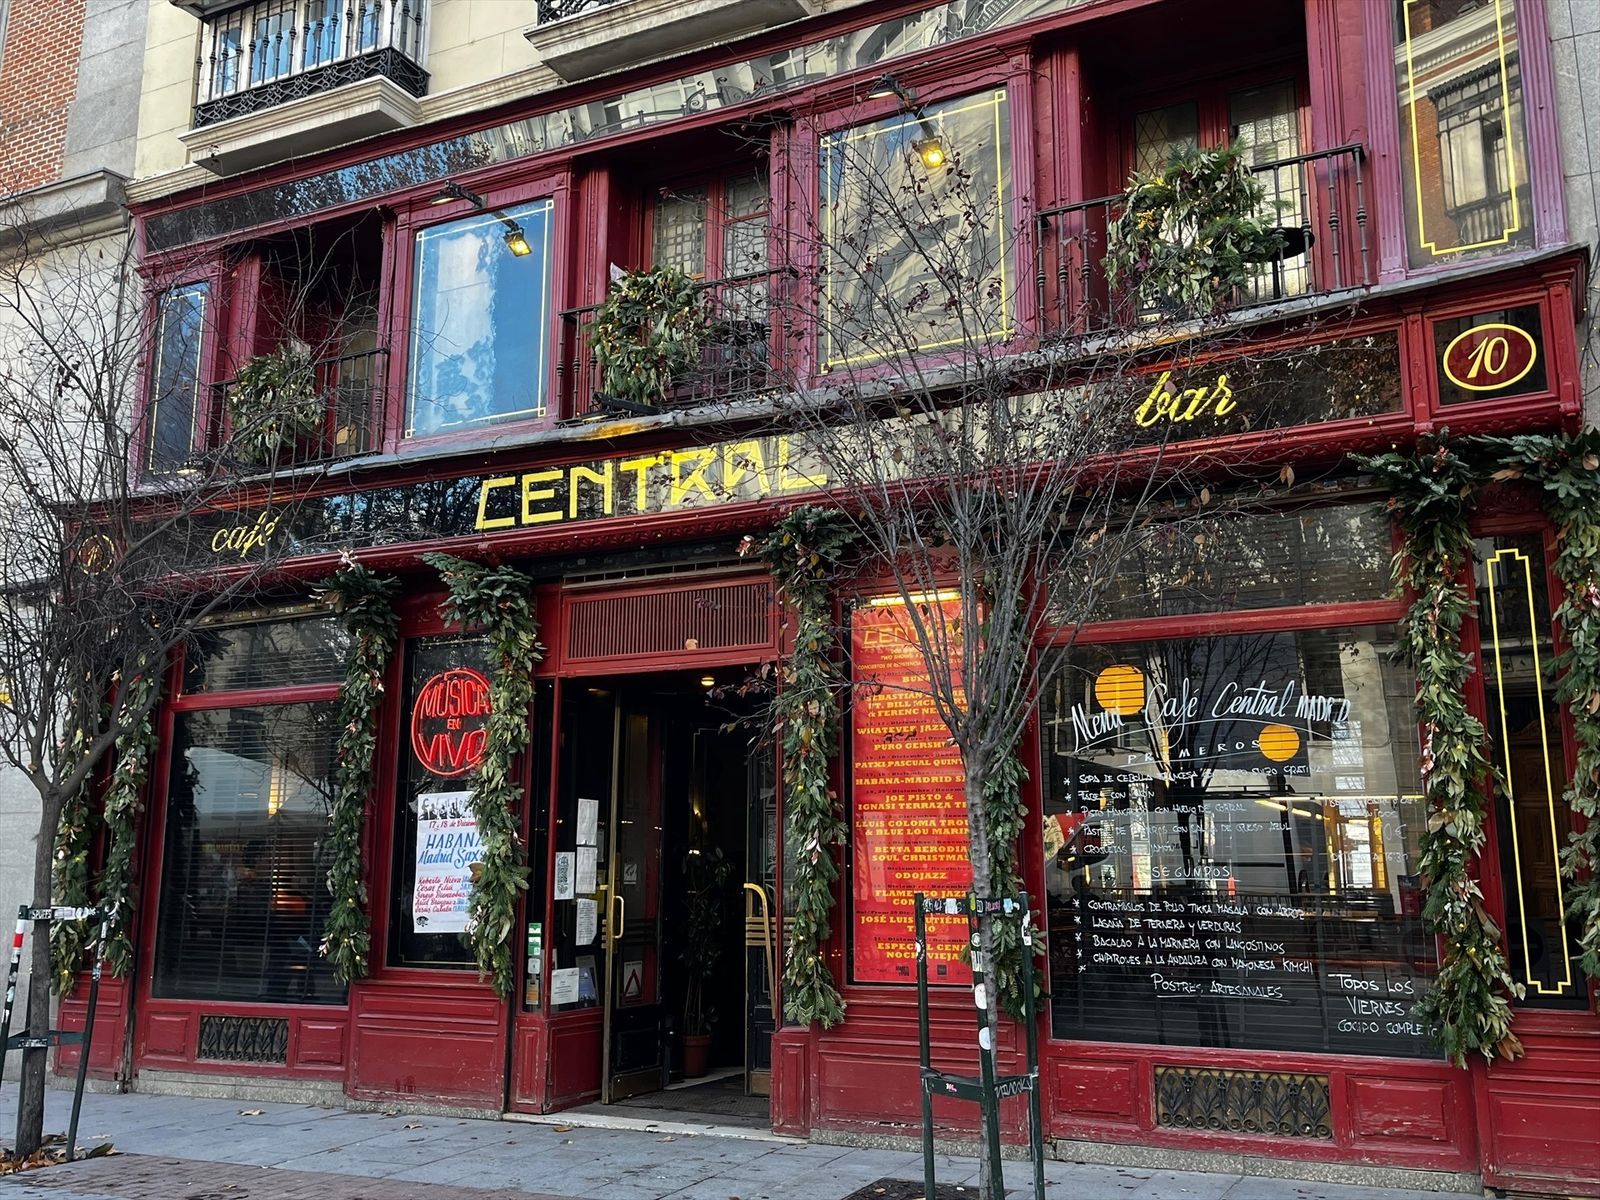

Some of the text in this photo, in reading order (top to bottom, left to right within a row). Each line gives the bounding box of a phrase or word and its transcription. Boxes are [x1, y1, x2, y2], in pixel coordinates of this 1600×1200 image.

[1466, 336, 1509, 379] 10
[1134, 371, 1237, 427] bar
[474, 434, 828, 531] CENTRAL
[211, 511, 280, 558] café
[887, 698, 912, 709] BILL
[1145, 677, 1200, 749] Café
[1211, 679, 1296, 718] Central
[1295, 694, 1351, 722] MADRID
[447, 718, 461, 730] EN
[920, 723, 947, 733] JAZZ
[418, 729, 487, 767] VIVO
[874, 743, 903, 752] PURO
[905, 740, 960, 750] GERSH
[1127, 739, 1261, 765] PRMEROS
[887, 758, 932, 768] PASCUAL
[933, 757, 964, 768] QUINT
[855, 775, 953, 786] HABANA-MADRID
[1079, 773, 1100, 784] SOPA
[1103, 774, 1114, 783] DE
[1116, 772, 1154, 783] CEBOLLA
[885, 792, 955, 803] JOE PISTO &
[1110, 791, 1127, 799] CON
[858, 803, 896, 811] IGNASI
[898, 800, 952, 810] TERRAZA
[1154, 805, 1170, 814] CON
[887, 819, 937, 828] COLOMA
[939, 818, 970, 828] TRO
[865, 828, 874, 836] &
[875, 828, 904, 836] BLUE
[906, 827, 930, 836] LOU
[1083, 823, 1114, 836] PAST
[1115, 826, 1127, 836] DE
[1172, 825, 1188, 833] CON
[1190, 824, 1218, 834] SALA
[874, 845, 969, 854] BETTA BERODIA
[417, 847, 455, 865] Madrid
[895, 871, 948, 880] ODOJAZZ
[875, 889, 939, 898] FLAMECO
[1088, 900, 1146, 912] CONTRAMUSLOS
[1148, 901, 1162, 912] DE
[1163, 900, 1185, 912] POLLO
[1187, 903, 1213, 914] TIKKA
[1215, 903, 1249, 916] MASALA
[1256, 906, 1273, 916] CON
[861, 914, 887, 924] JOSÉ
[889, 915, 914, 924] LUIS
[1128, 917, 1142, 929] DE
[1142, 919, 1186, 930] TERNERA
[1197, 920, 1242, 933] VERDURAS
[877, 942, 935, 952] ESPECL
[1092, 934, 1133, 948] BACALAO
[1137, 935, 1145, 948] A
[1147, 936, 1158, 949] LA
[1205, 939, 1221, 950] CON
[1145, 953, 1153, 965] A
[1154, 954, 1165, 965] LA
[1211, 958, 1228, 969] CON
[1230, 957, 1276, 977] MAYONESA
[1282, 957, 1314, 976] KIMCHI
[1209, 979, 1284, 999] ARTESANALES
[1327, 973, 1415, 995] TODOS LOS
[1345, 995, 1406, 1017] VIERNES
